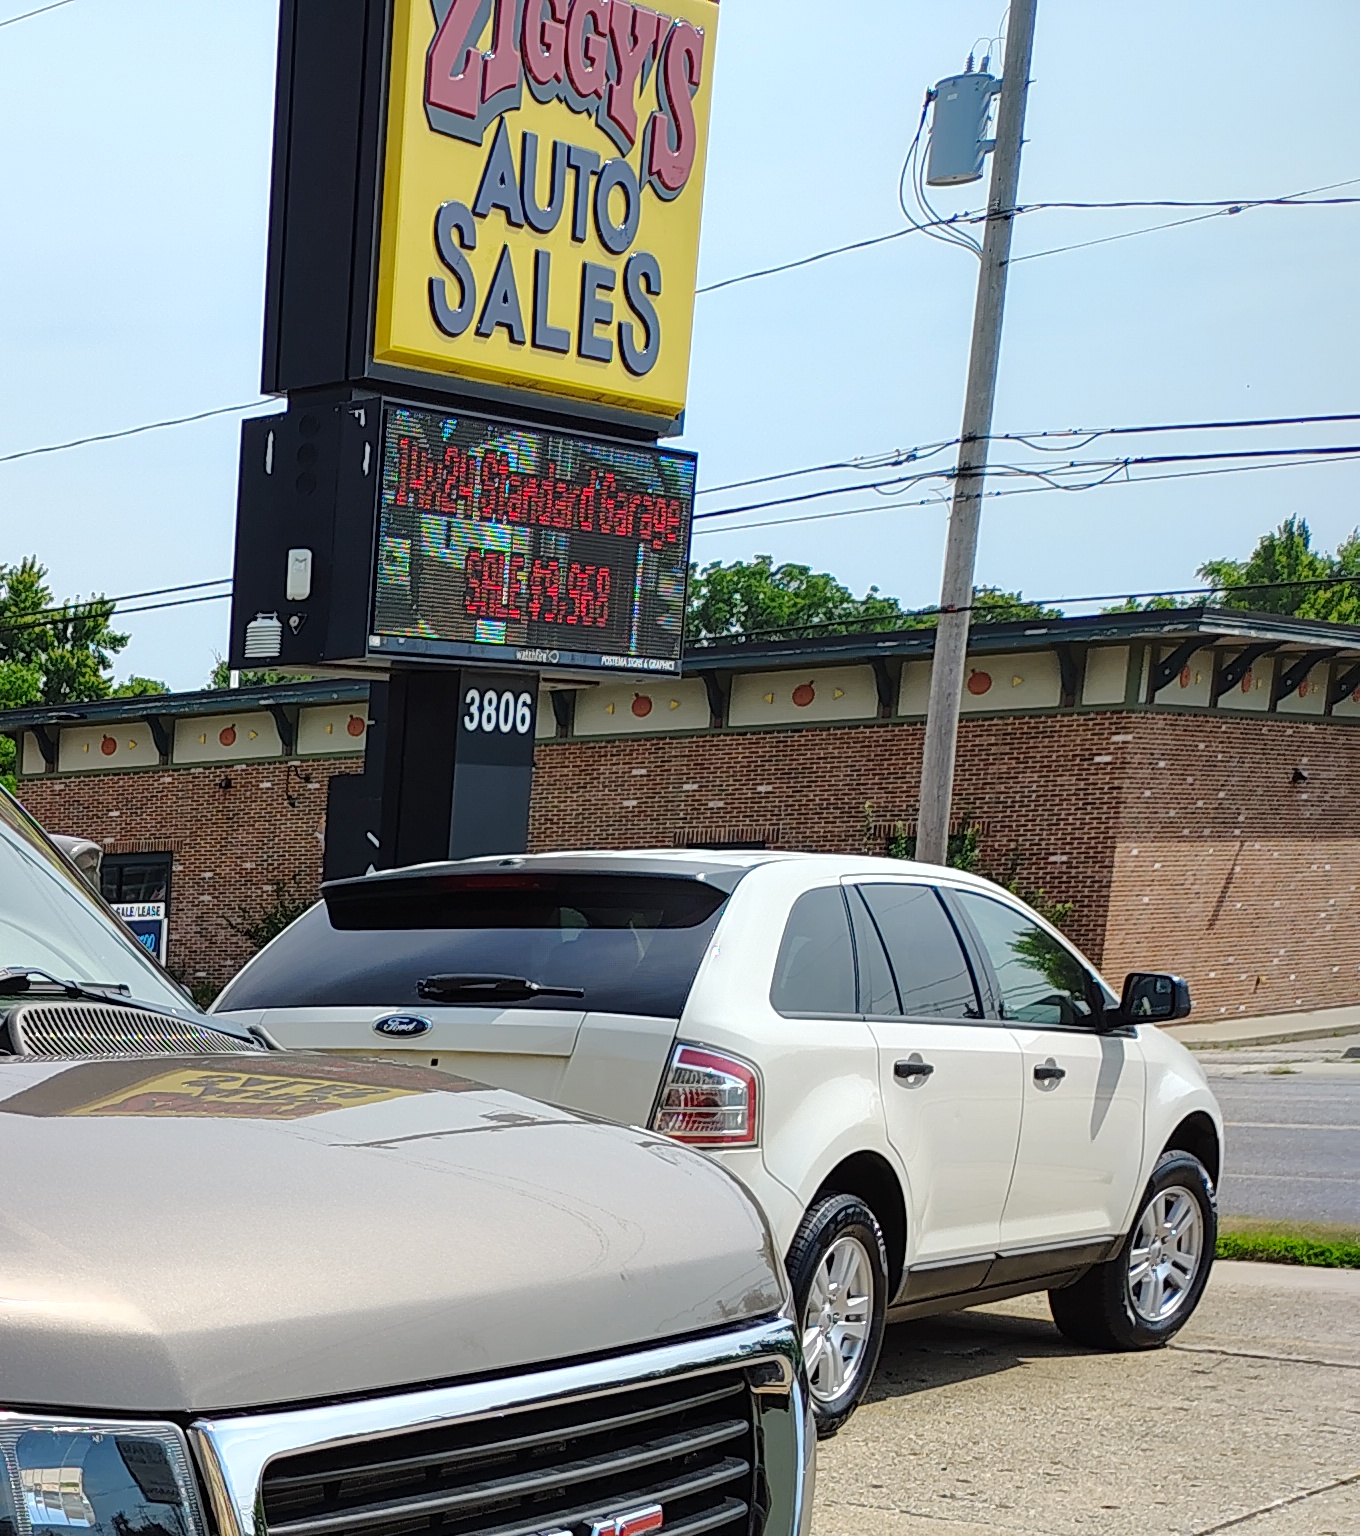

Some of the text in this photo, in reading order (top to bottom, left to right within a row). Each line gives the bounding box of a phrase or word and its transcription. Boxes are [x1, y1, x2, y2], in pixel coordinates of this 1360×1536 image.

[423, 0, 705, 202] ZIGGY'S
[471, 114, 641, 256] AUTO
[428, 201, 662, 377] SALES
[599, 472, 680, 550] Garage
[463, 688, 532, 734] 3806
[383, 1018, 418, 1032] Ford
